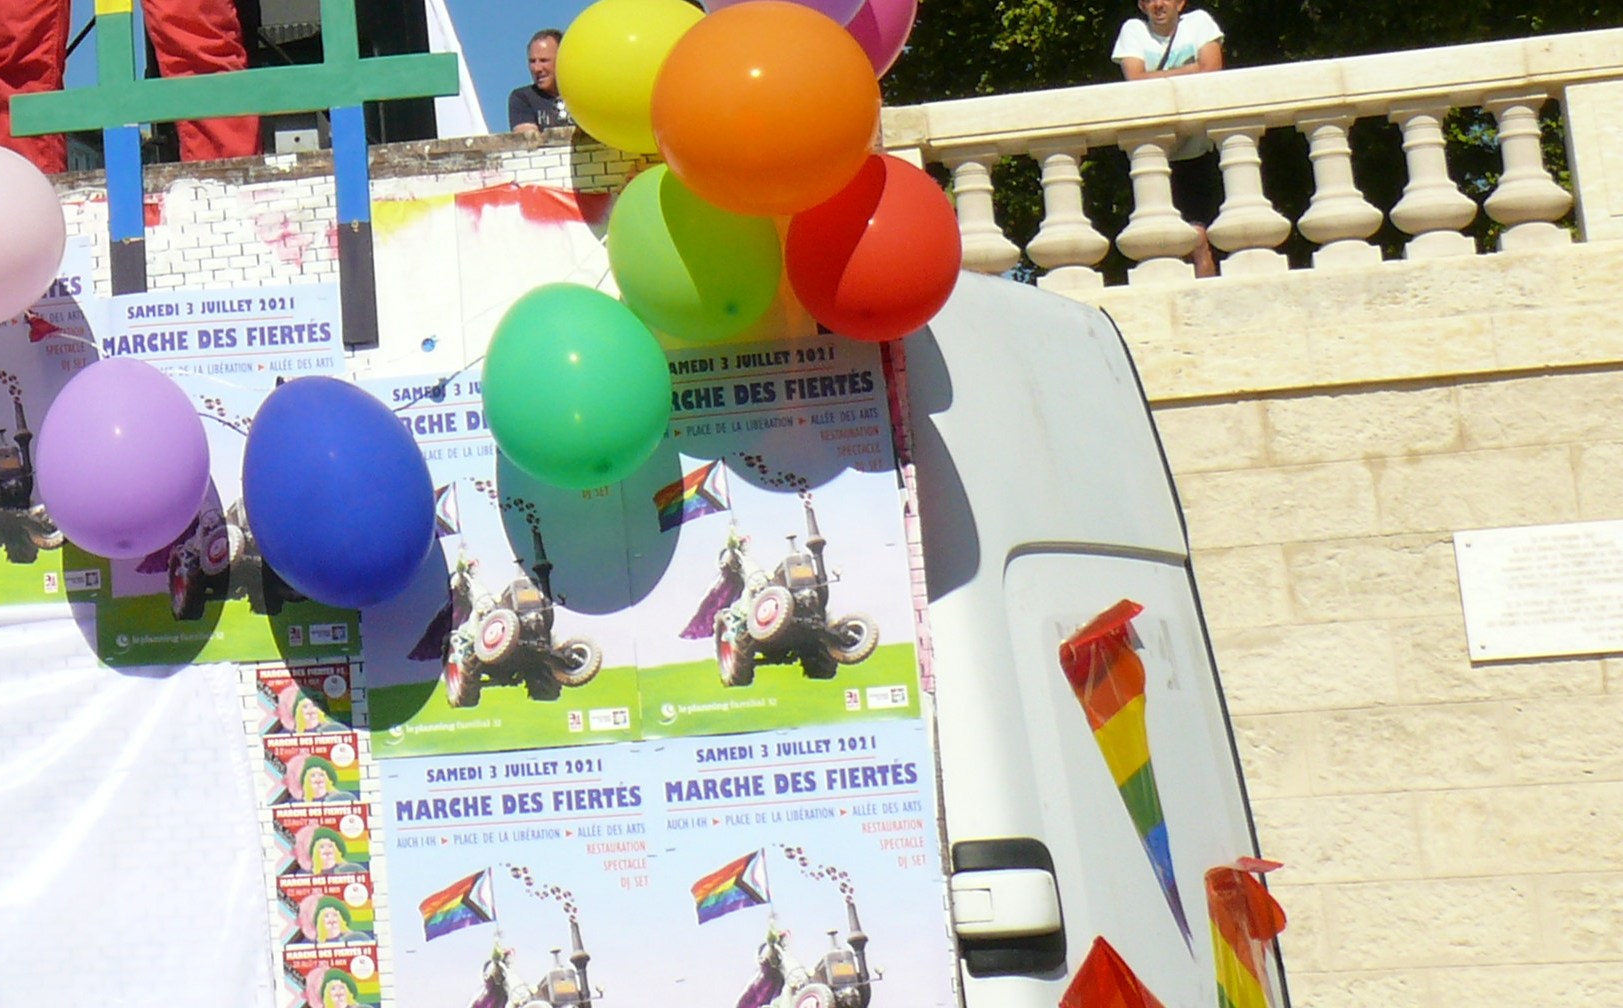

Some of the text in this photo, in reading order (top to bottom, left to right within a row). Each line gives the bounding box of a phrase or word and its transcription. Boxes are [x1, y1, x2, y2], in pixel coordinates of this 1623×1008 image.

[128, 297, 294, 319] SAMEDI 3 JUILLET 2021
[103, 318, 331, 358] MARCHE DES FIERTÉS
[194, 357, 333, 375] LA LIBÉRATION ALLÉE DES ARTS
[668, 347, 835, 375] AMEDI 3 JUILLET 2021
[454, 384, 460, 395] 3
[671, 369, 874, 412] RCHE DES FIERTÉS
[687, 408, 878, 437] PLACE DE LA LIBÉRATION ALLÉE DES ARTS
[448, 447, 472, 459] DE LA
[696, 736, 876, 763] SAMEDI 3 JUILLET 2021
[427, 758, 602, 783] SAMEDI 3 JUILLET 2021
[665, 759, 917, 802] MARCHE DES FIERTÉS
[396, 781, 641, 821] MARCHE DES FIERTÉS
[667, 819, 688, 830] AUCH
[726, 813, 750, 825] PLACE
[756, 812, 766, 824] DE
[772, 811, 781, 822] LA
[787, 806, 834, 822] LIBÉRATION
[852, 803, 876, 816] ALLÉE
[883, 802, 898, 813] DES
[903, 800, 922, 812] ARTS
[862, 820, 923, 833] RESTAURATION
[397, 837, 418, 848] AUCH
[453, 833, 477, 845] PLACE
[483, 832, 493, 843] DE
[499, 831, 508, 842] LA
[513, 826, 560, 841] LIBÉRATION
[578, 825, 601, 837] ALLÉE
[607, 825, 622, 836] DES
[626, 823, 645, 834] ARTS
[880, 837, 923, 850] SPECTACLE
[587, 843, 646, 855] RESTAURATION
[603, 859, 646, 870] SPECTACLE
[898, 855, 926, 868] DJ SET
[621, 876, 648, 889] DJ SET
